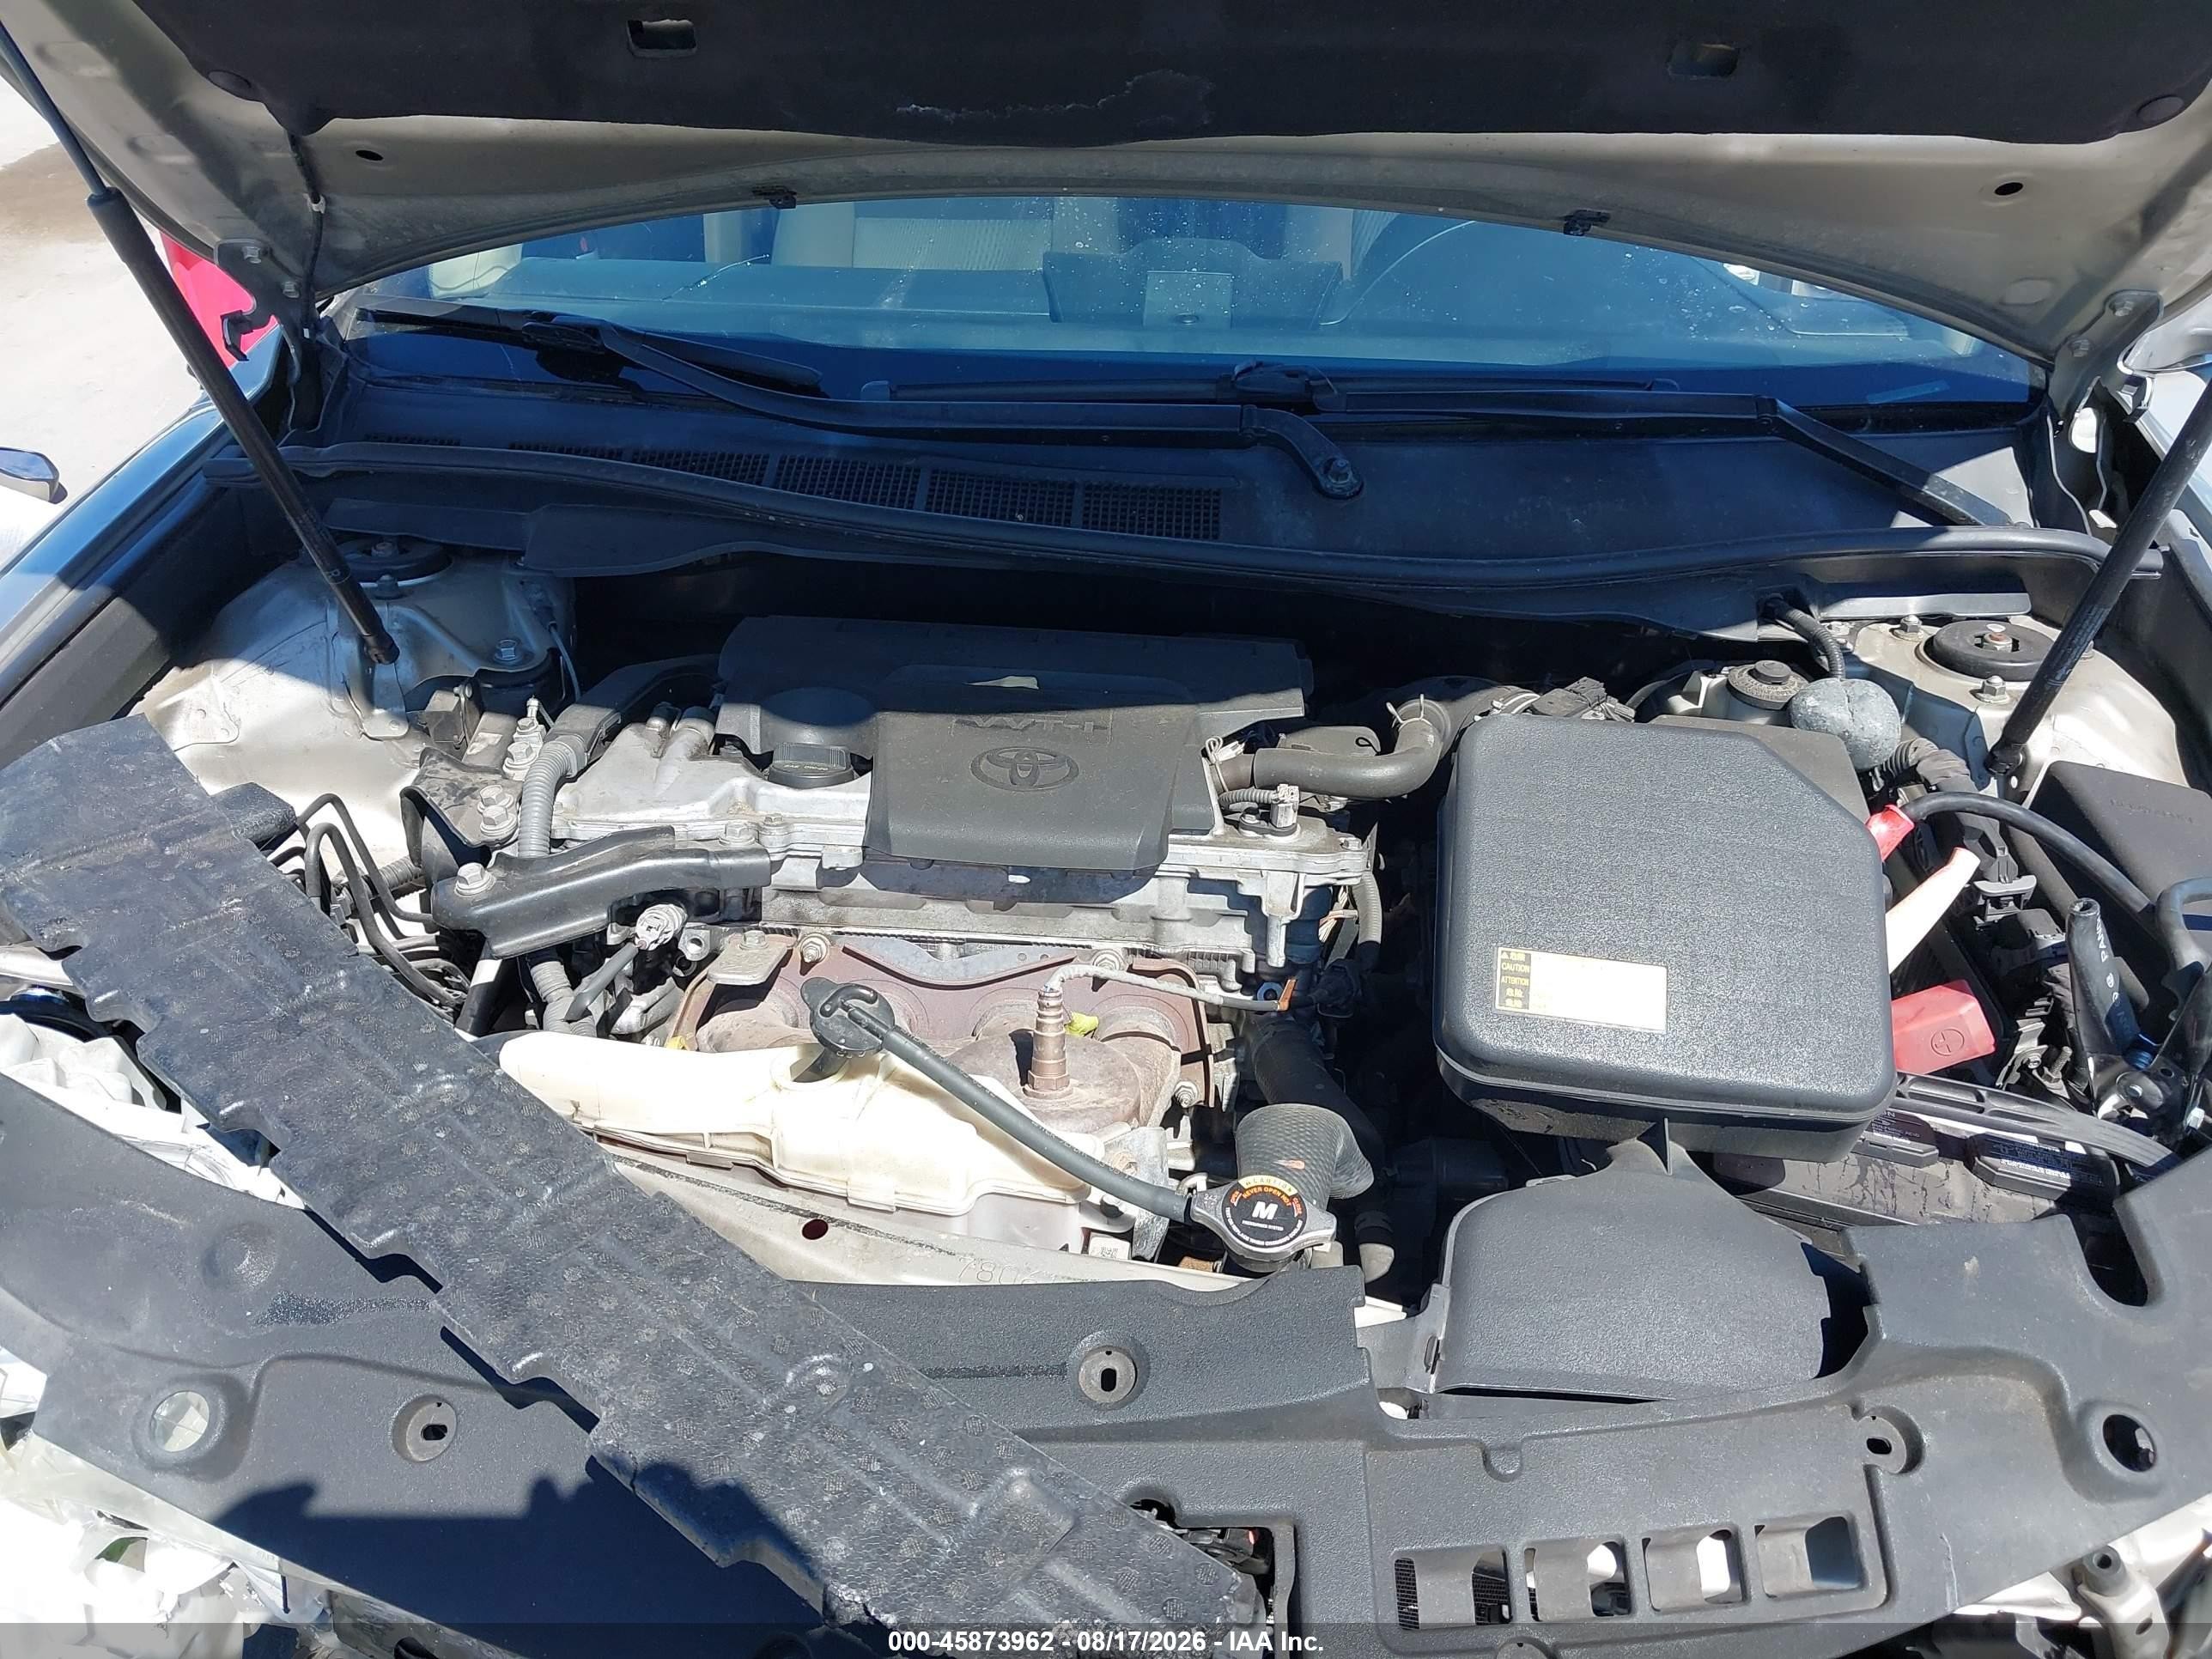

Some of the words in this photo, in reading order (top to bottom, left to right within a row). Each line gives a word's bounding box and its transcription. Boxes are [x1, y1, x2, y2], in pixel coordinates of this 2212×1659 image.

[1501, 963, 1530, 973] CAUTION
[1501, 975, 1529, 986] ATTENTION
[1243, 1187, 1262, 1199] NEVER
[1263, 1187, 1286, 1199] OPEN
[1252, 1200, 1279, 1219] M
